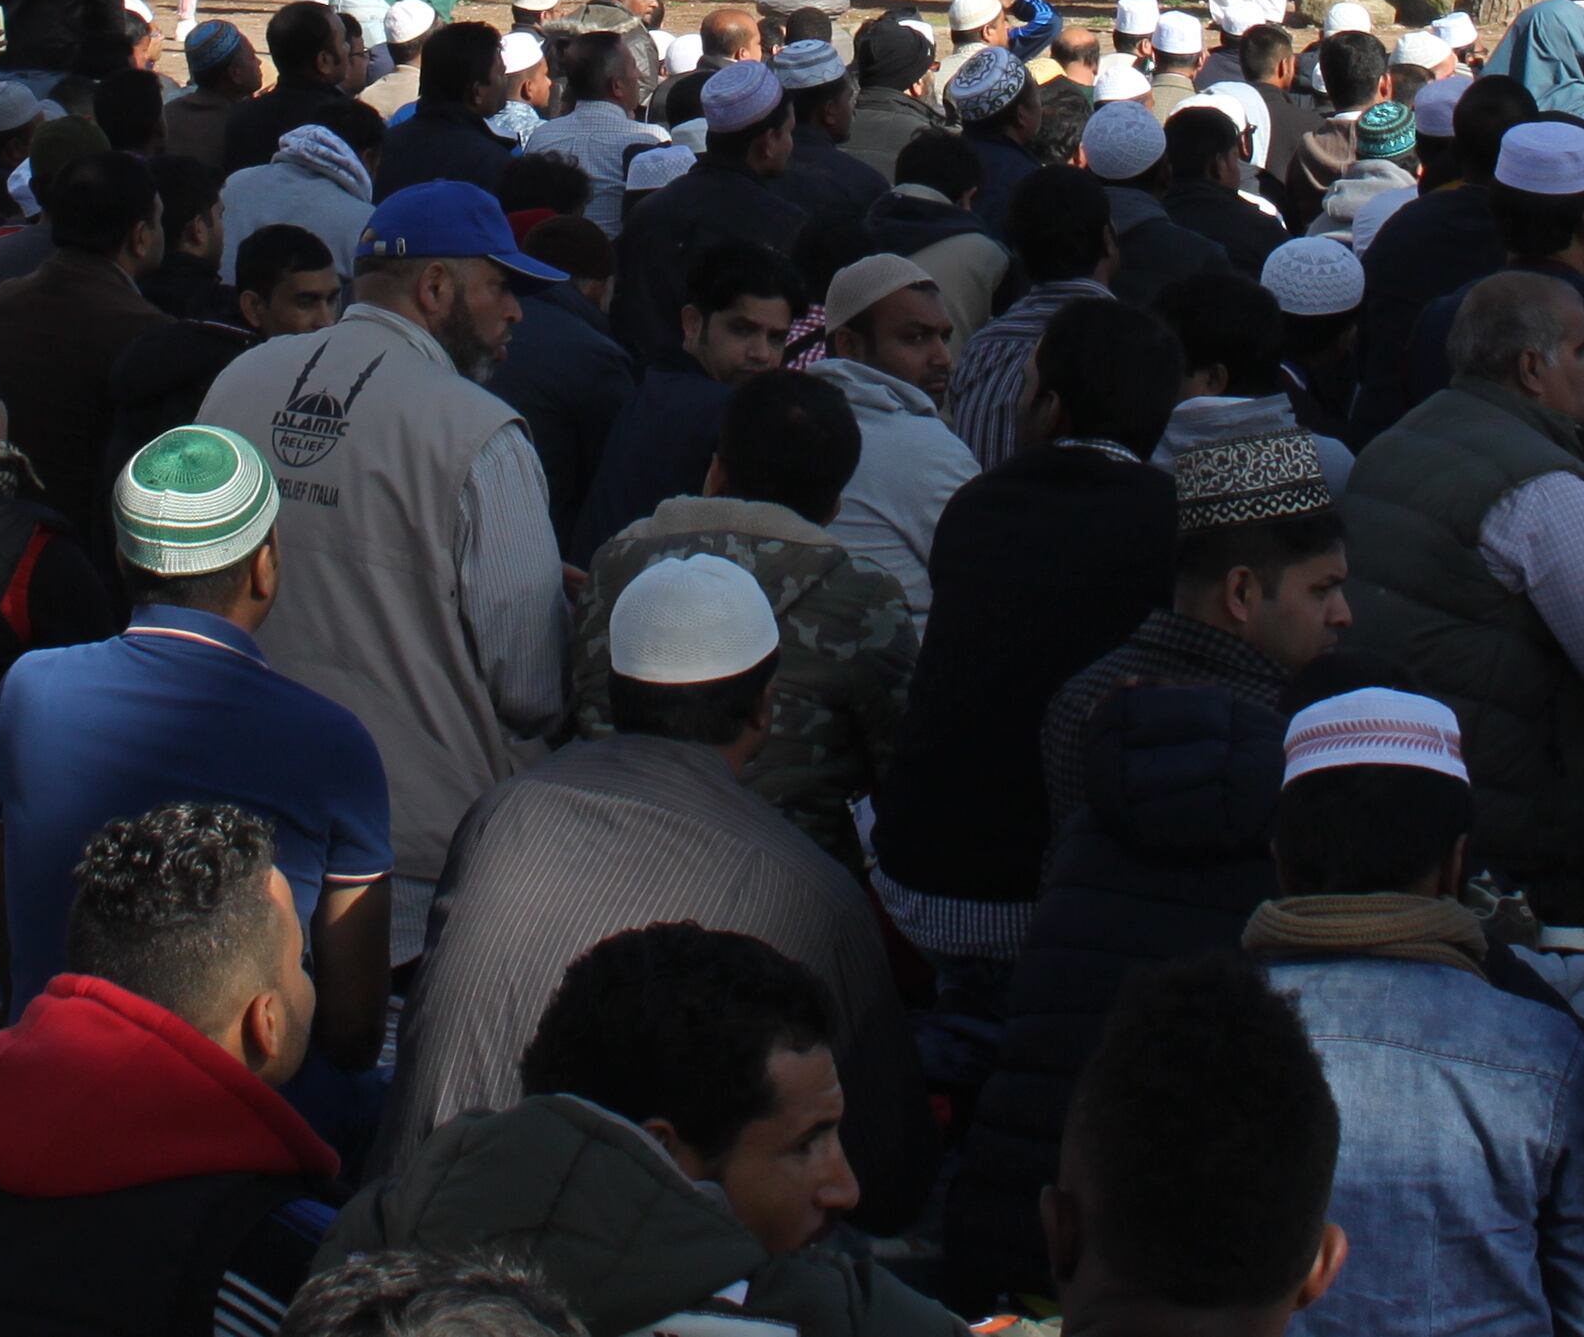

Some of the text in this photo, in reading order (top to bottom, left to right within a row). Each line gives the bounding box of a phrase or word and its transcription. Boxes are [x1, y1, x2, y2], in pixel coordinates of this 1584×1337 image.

[272, 411, 351, 437] ISLAMIC
[279, 435, 326, 452] RELIEF
[308, 483, 340, 509] ITALIA
